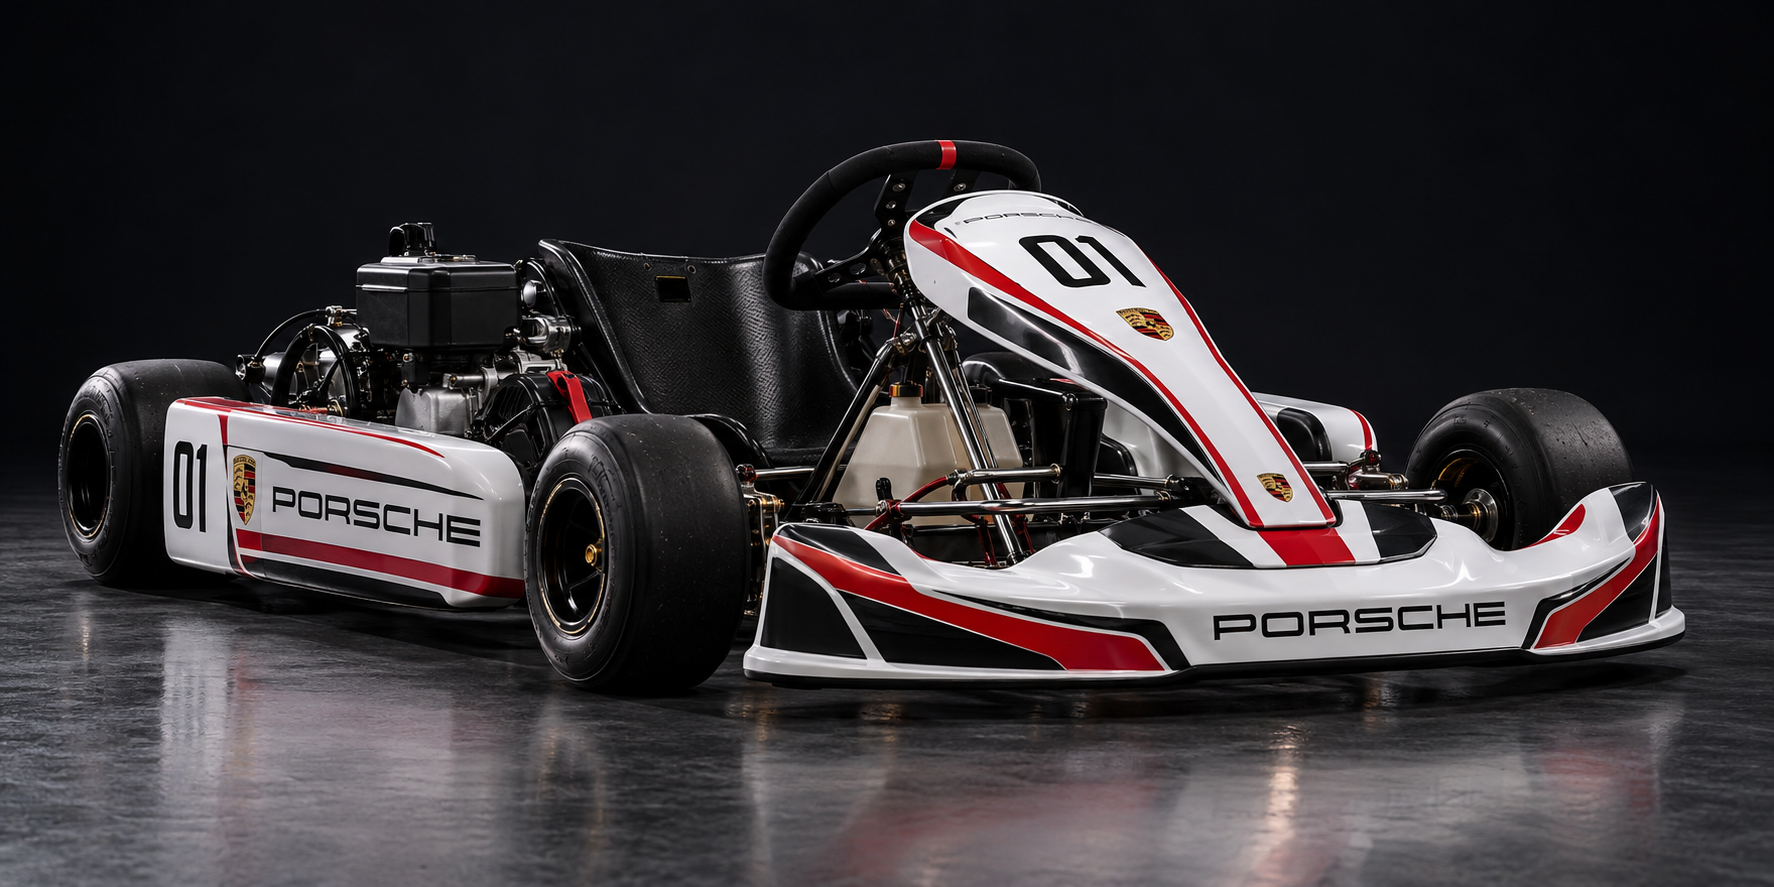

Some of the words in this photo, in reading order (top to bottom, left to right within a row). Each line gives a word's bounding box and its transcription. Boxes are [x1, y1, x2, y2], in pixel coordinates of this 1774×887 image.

[1019, 234, 1147, 288] 01
[173, 441, 208, 532] 01
[272, 486, 481, 547] PORSCHE
[1213, 601, 1506, 640] PORSCHE
